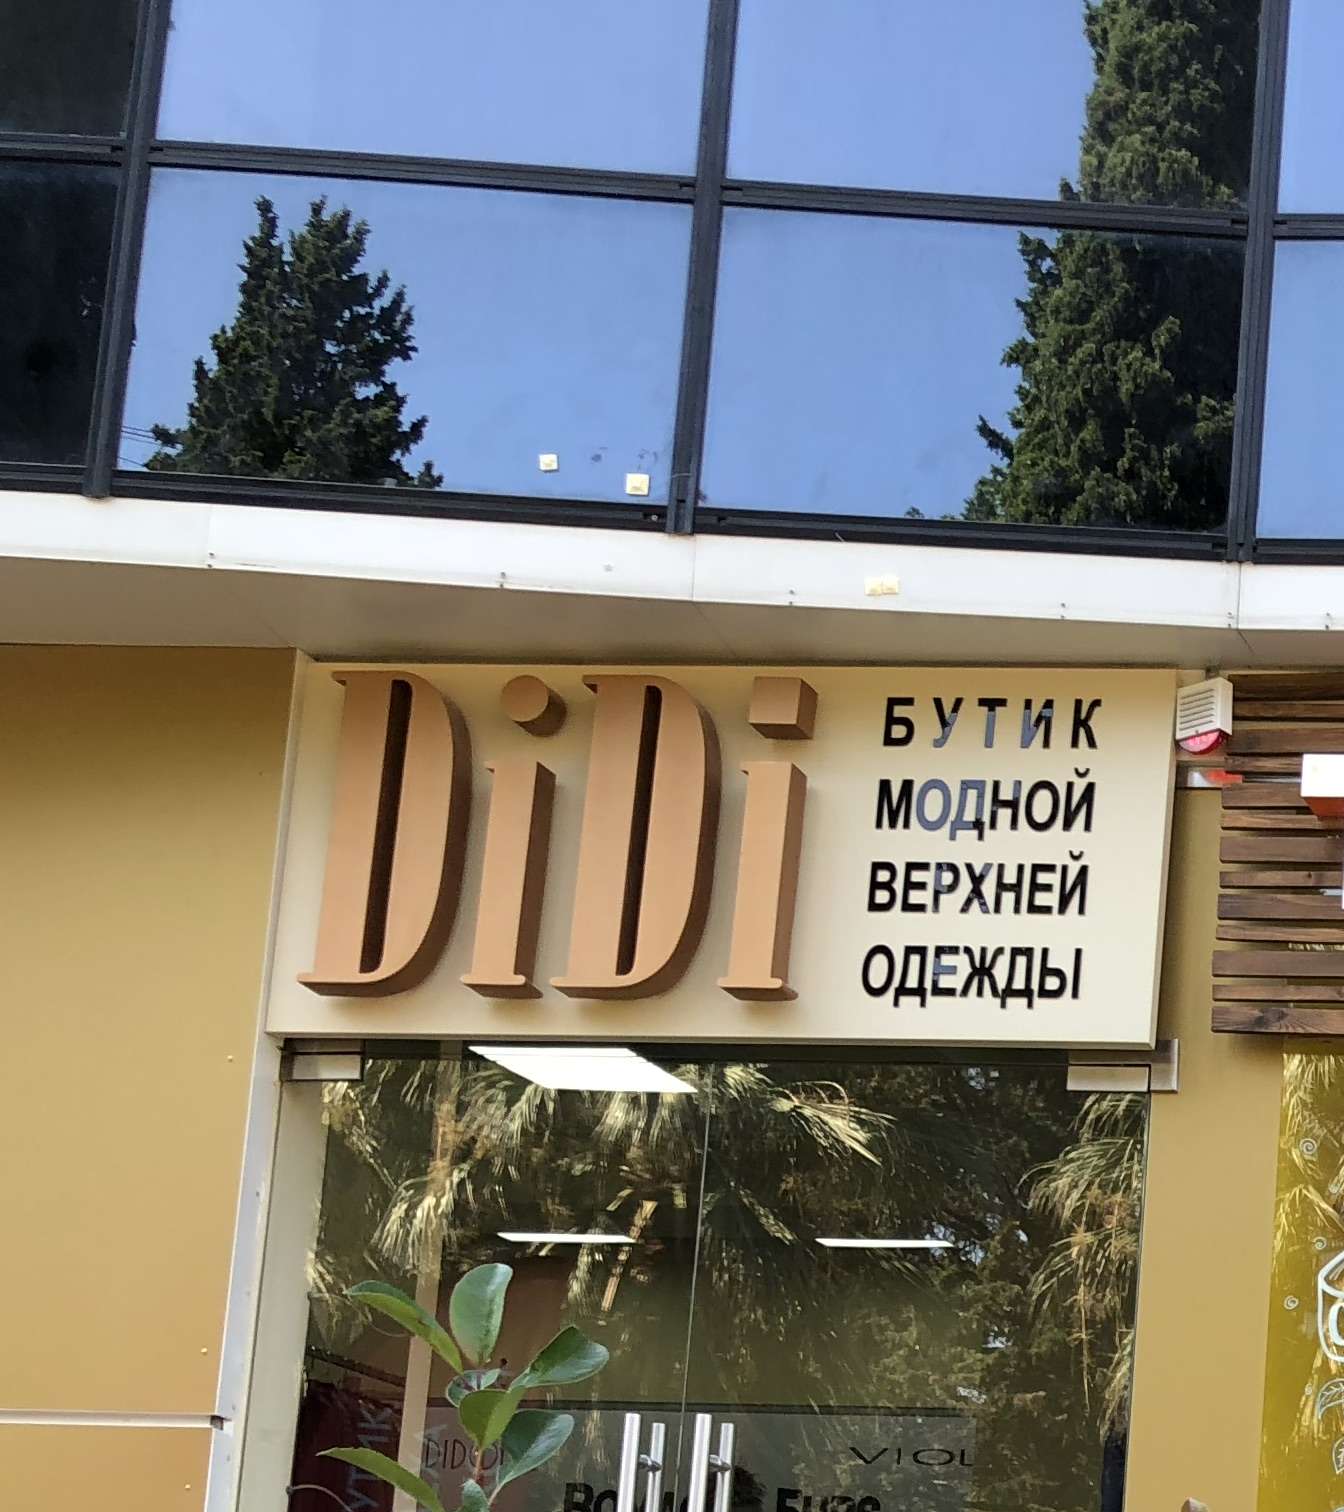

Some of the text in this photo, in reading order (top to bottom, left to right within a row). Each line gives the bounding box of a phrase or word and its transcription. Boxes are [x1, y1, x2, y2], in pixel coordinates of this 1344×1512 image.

[882, 695, 1103, 749] БУТИК
[296, 669, 818, 1000] DiDi
[874, 766, 1096, 841] МОДНОЙ
[866, 850, 1090, 918] ВЕРХНЕЙ
[860, 943, 1083, 1010] ОДЕЖДЫ
